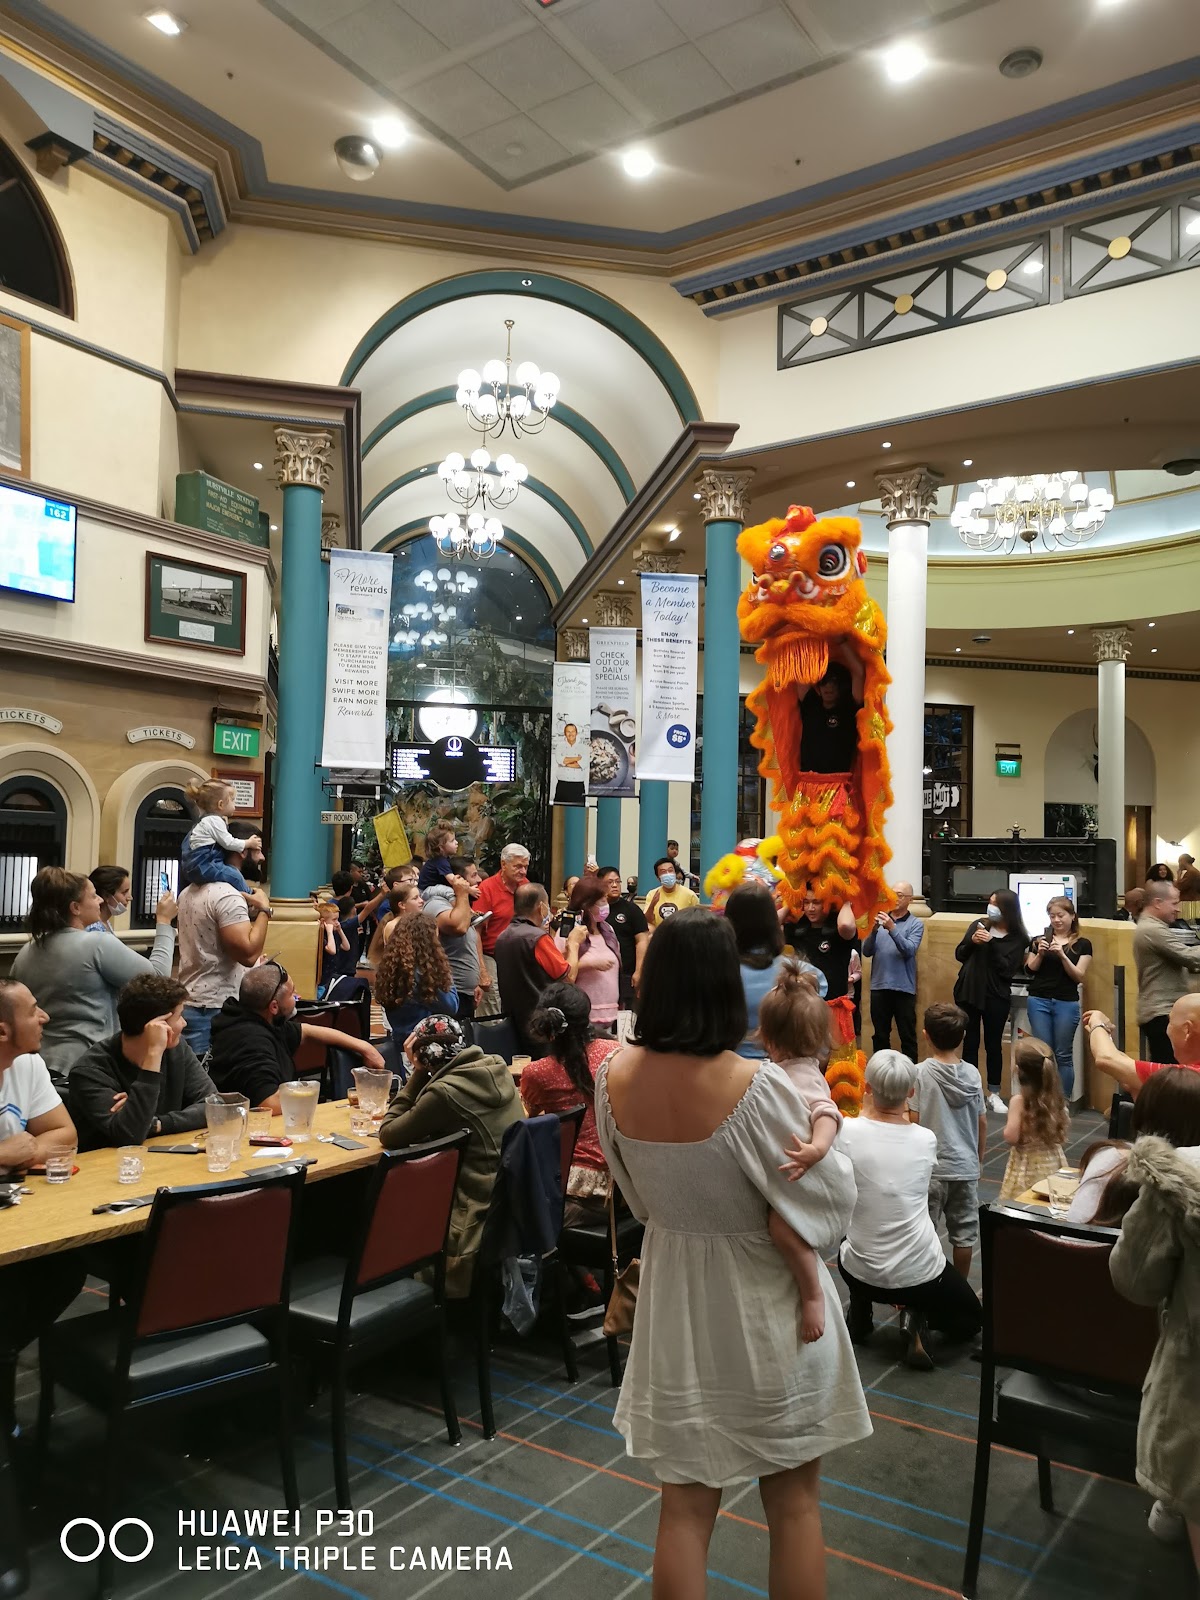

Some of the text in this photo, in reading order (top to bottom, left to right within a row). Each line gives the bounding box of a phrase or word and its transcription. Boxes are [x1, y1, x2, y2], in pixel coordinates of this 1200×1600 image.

[236, 493, 255, 508] STATION
[49, 507, 67, 519] 162
[230, 500, 253, 515] EQUIPMENT
[205, 500, 221, 513] MAJOR
[221, 508, 244, 524] EMERGENCY
[244, 518, 255, 529] ONLY
[334, 567, 380, 585] More
[350, 585, 388, 595] rewards
[651, 581, 690, 593] Become
[654, 597, 696, 608] Member
[653, 610, 689, 625] Today!
[600, 651, 625, 659] CHECK
[612, 659, 630, 667] OUR
[556, 675, 577, 687] Thank
[595, 673, 630, 681] SPECIALS!
[332, 687, 356, 695] SWIPE
[0, 710, 46, 724] TICKETS
[337, 706, 375, 717] Rewards
[655, 710, 681, 720] & More
[142, 728, 183, 741] TICKETS
[221, 730, 252, 752] EXIT
[1000, 763, 1017, 774] EXIT
[923, 792, 932, 805] HE
[322, 814, 354, 822] EST ROOMS
